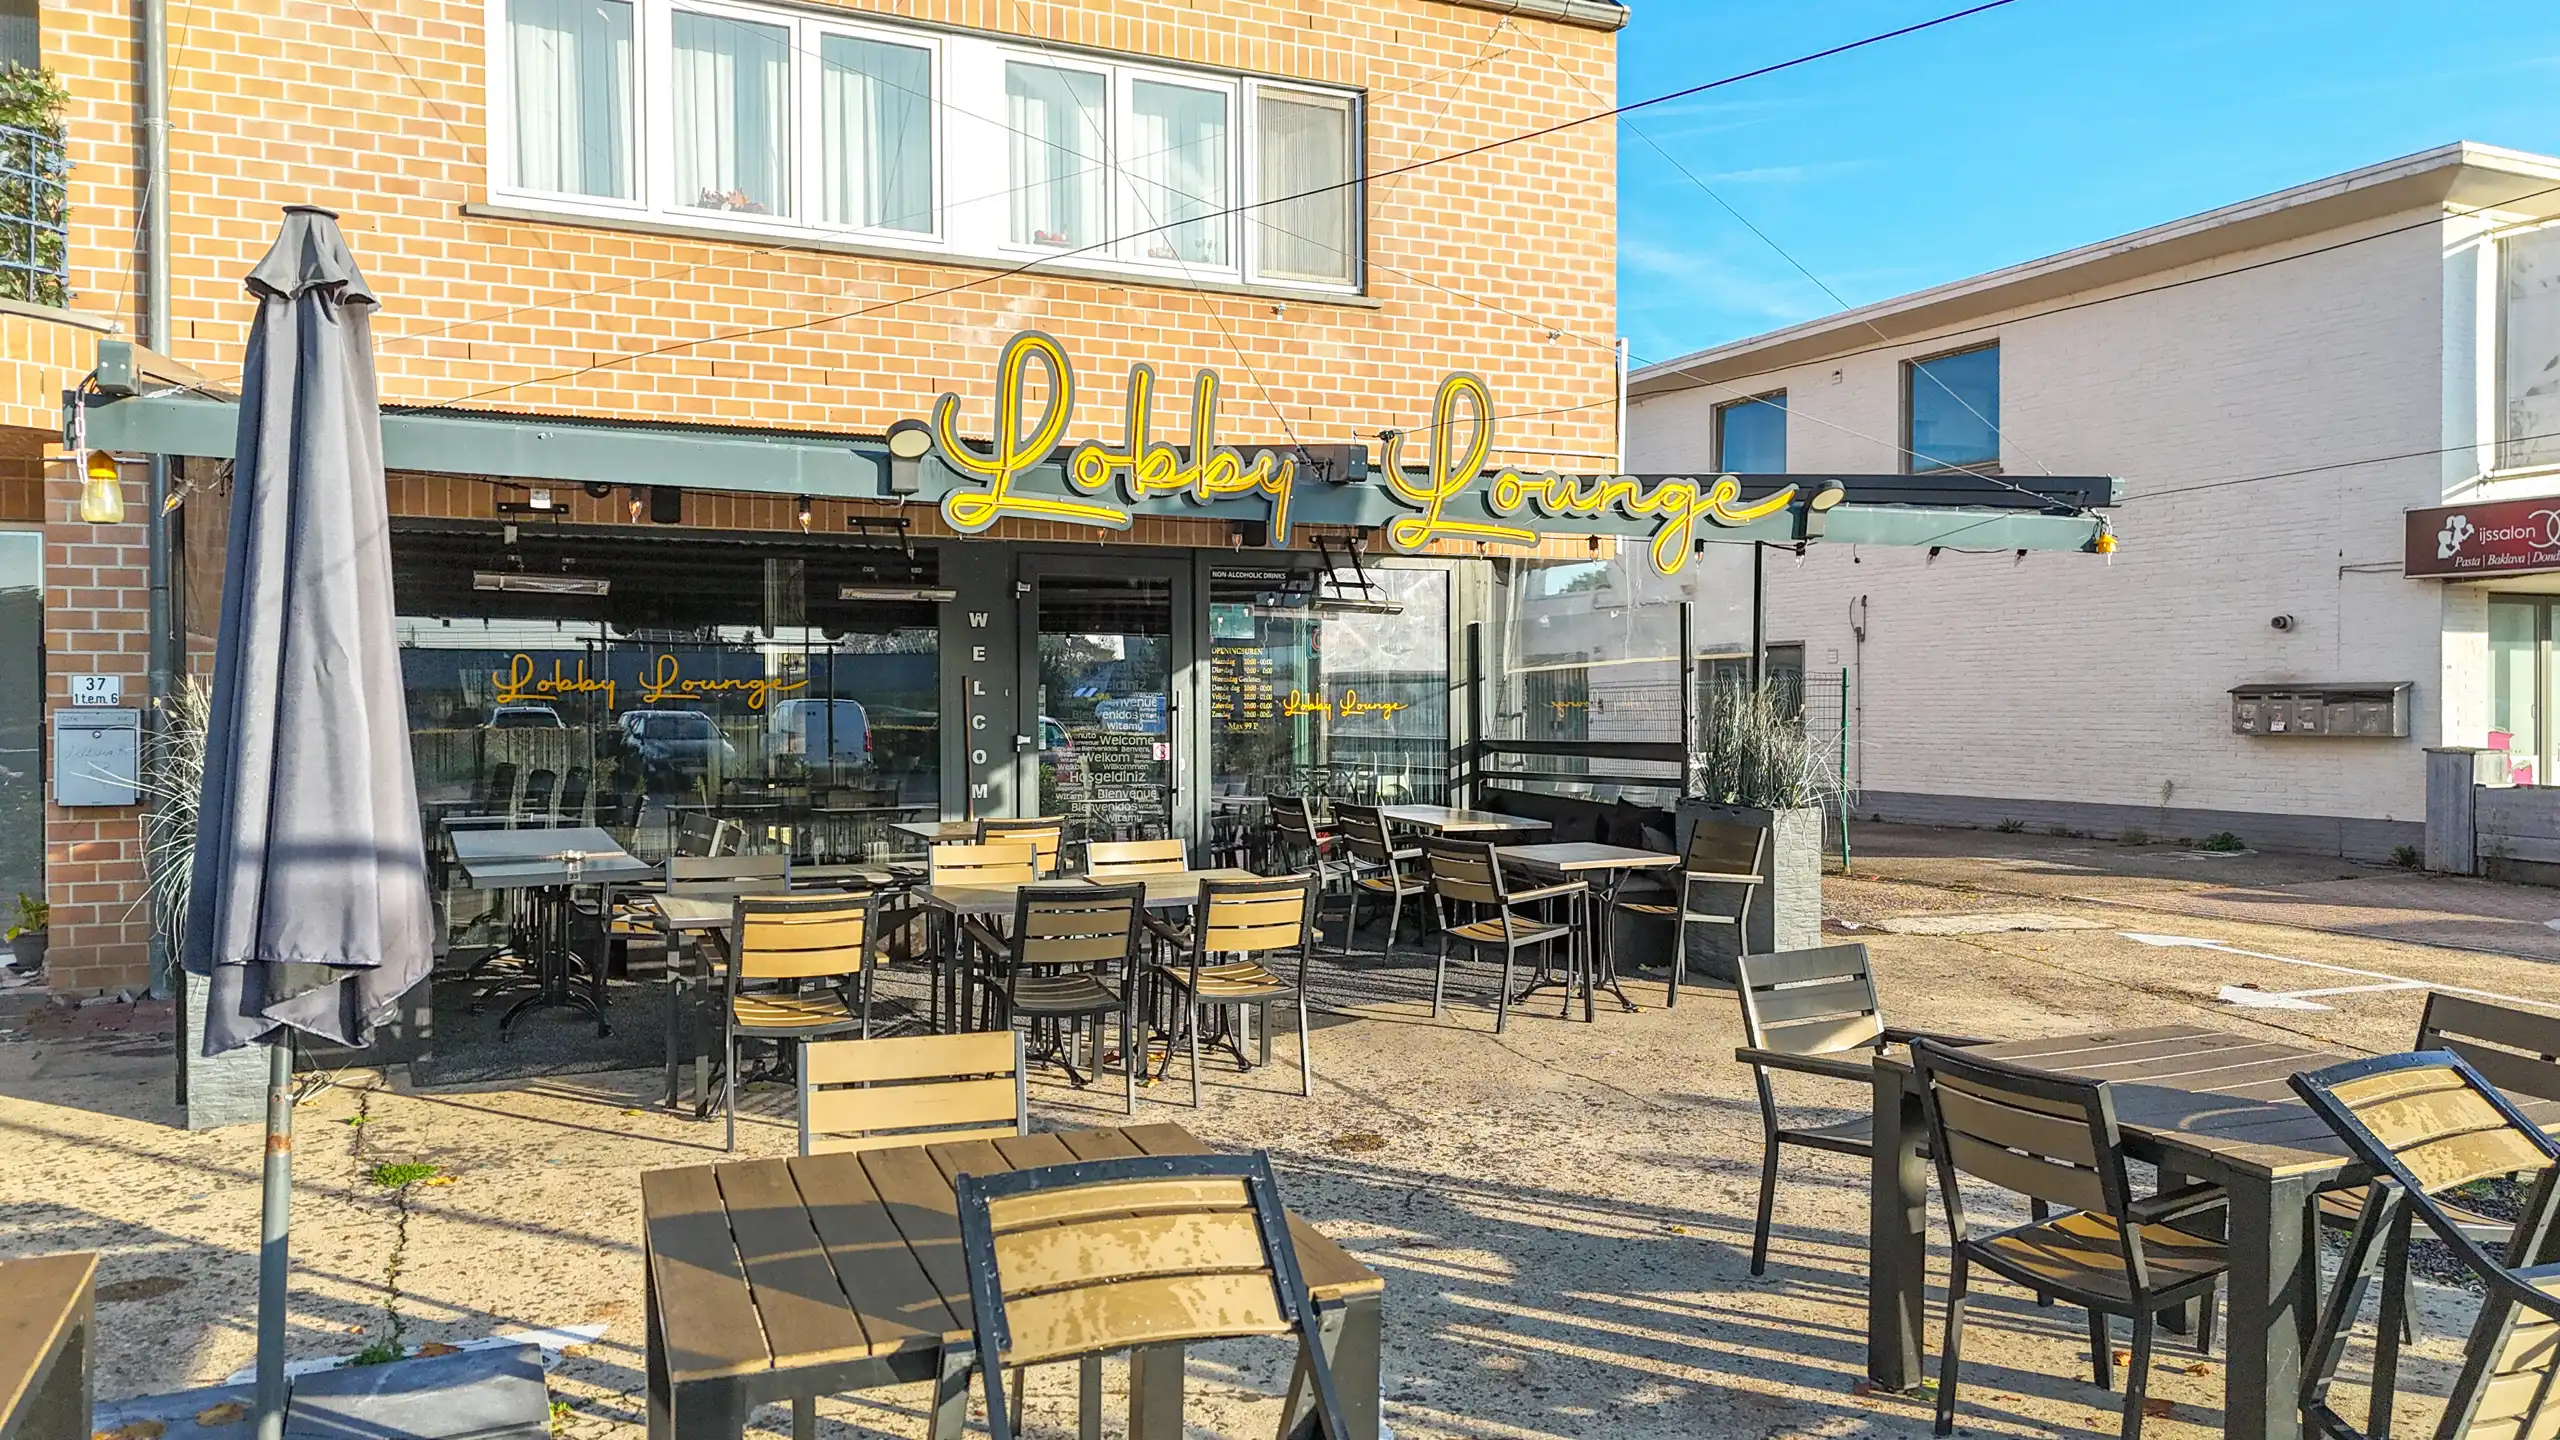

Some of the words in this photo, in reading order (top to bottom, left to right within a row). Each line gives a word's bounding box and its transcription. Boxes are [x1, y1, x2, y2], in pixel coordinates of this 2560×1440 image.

[935, 333, 1299, 547] Lobby
[1385, 373, 1797, 575] Lounge
[2479, 525, 2536, 545] ijssalon
[2455, 555, 2481, 568] Pasta
[2487, 553, 2525, 565] Baklava
[2532, 550, 2560, 563] Dond
[1264, 572, 1286, 580] DRINKS
[86, 677, 106, 691] 37
[493, 653, 616, 710] Lobby
[639, 654, 808, 710] Lounge
[74, 693, 79, 703] 1
[111, 693, 118, 704] 6
[1283, 690, 1332, 720] Lobby
[1340, 690, 1409, 720] Lounge
[968, 612, 988, 822] WELCOM
[1107, 722, 1144, 732] Witamy
[1100, 735, 1155, 746] Welcome
[1083, 752, 1130, 763] Welkom
[1103, 764, 1150, 772] Willkommen
[1097, 788, 1157, 799] Bienvenue
[1071, 803, 1138, 813] Bienvenidos
[1106, 813, 1144, 823] Witamy
